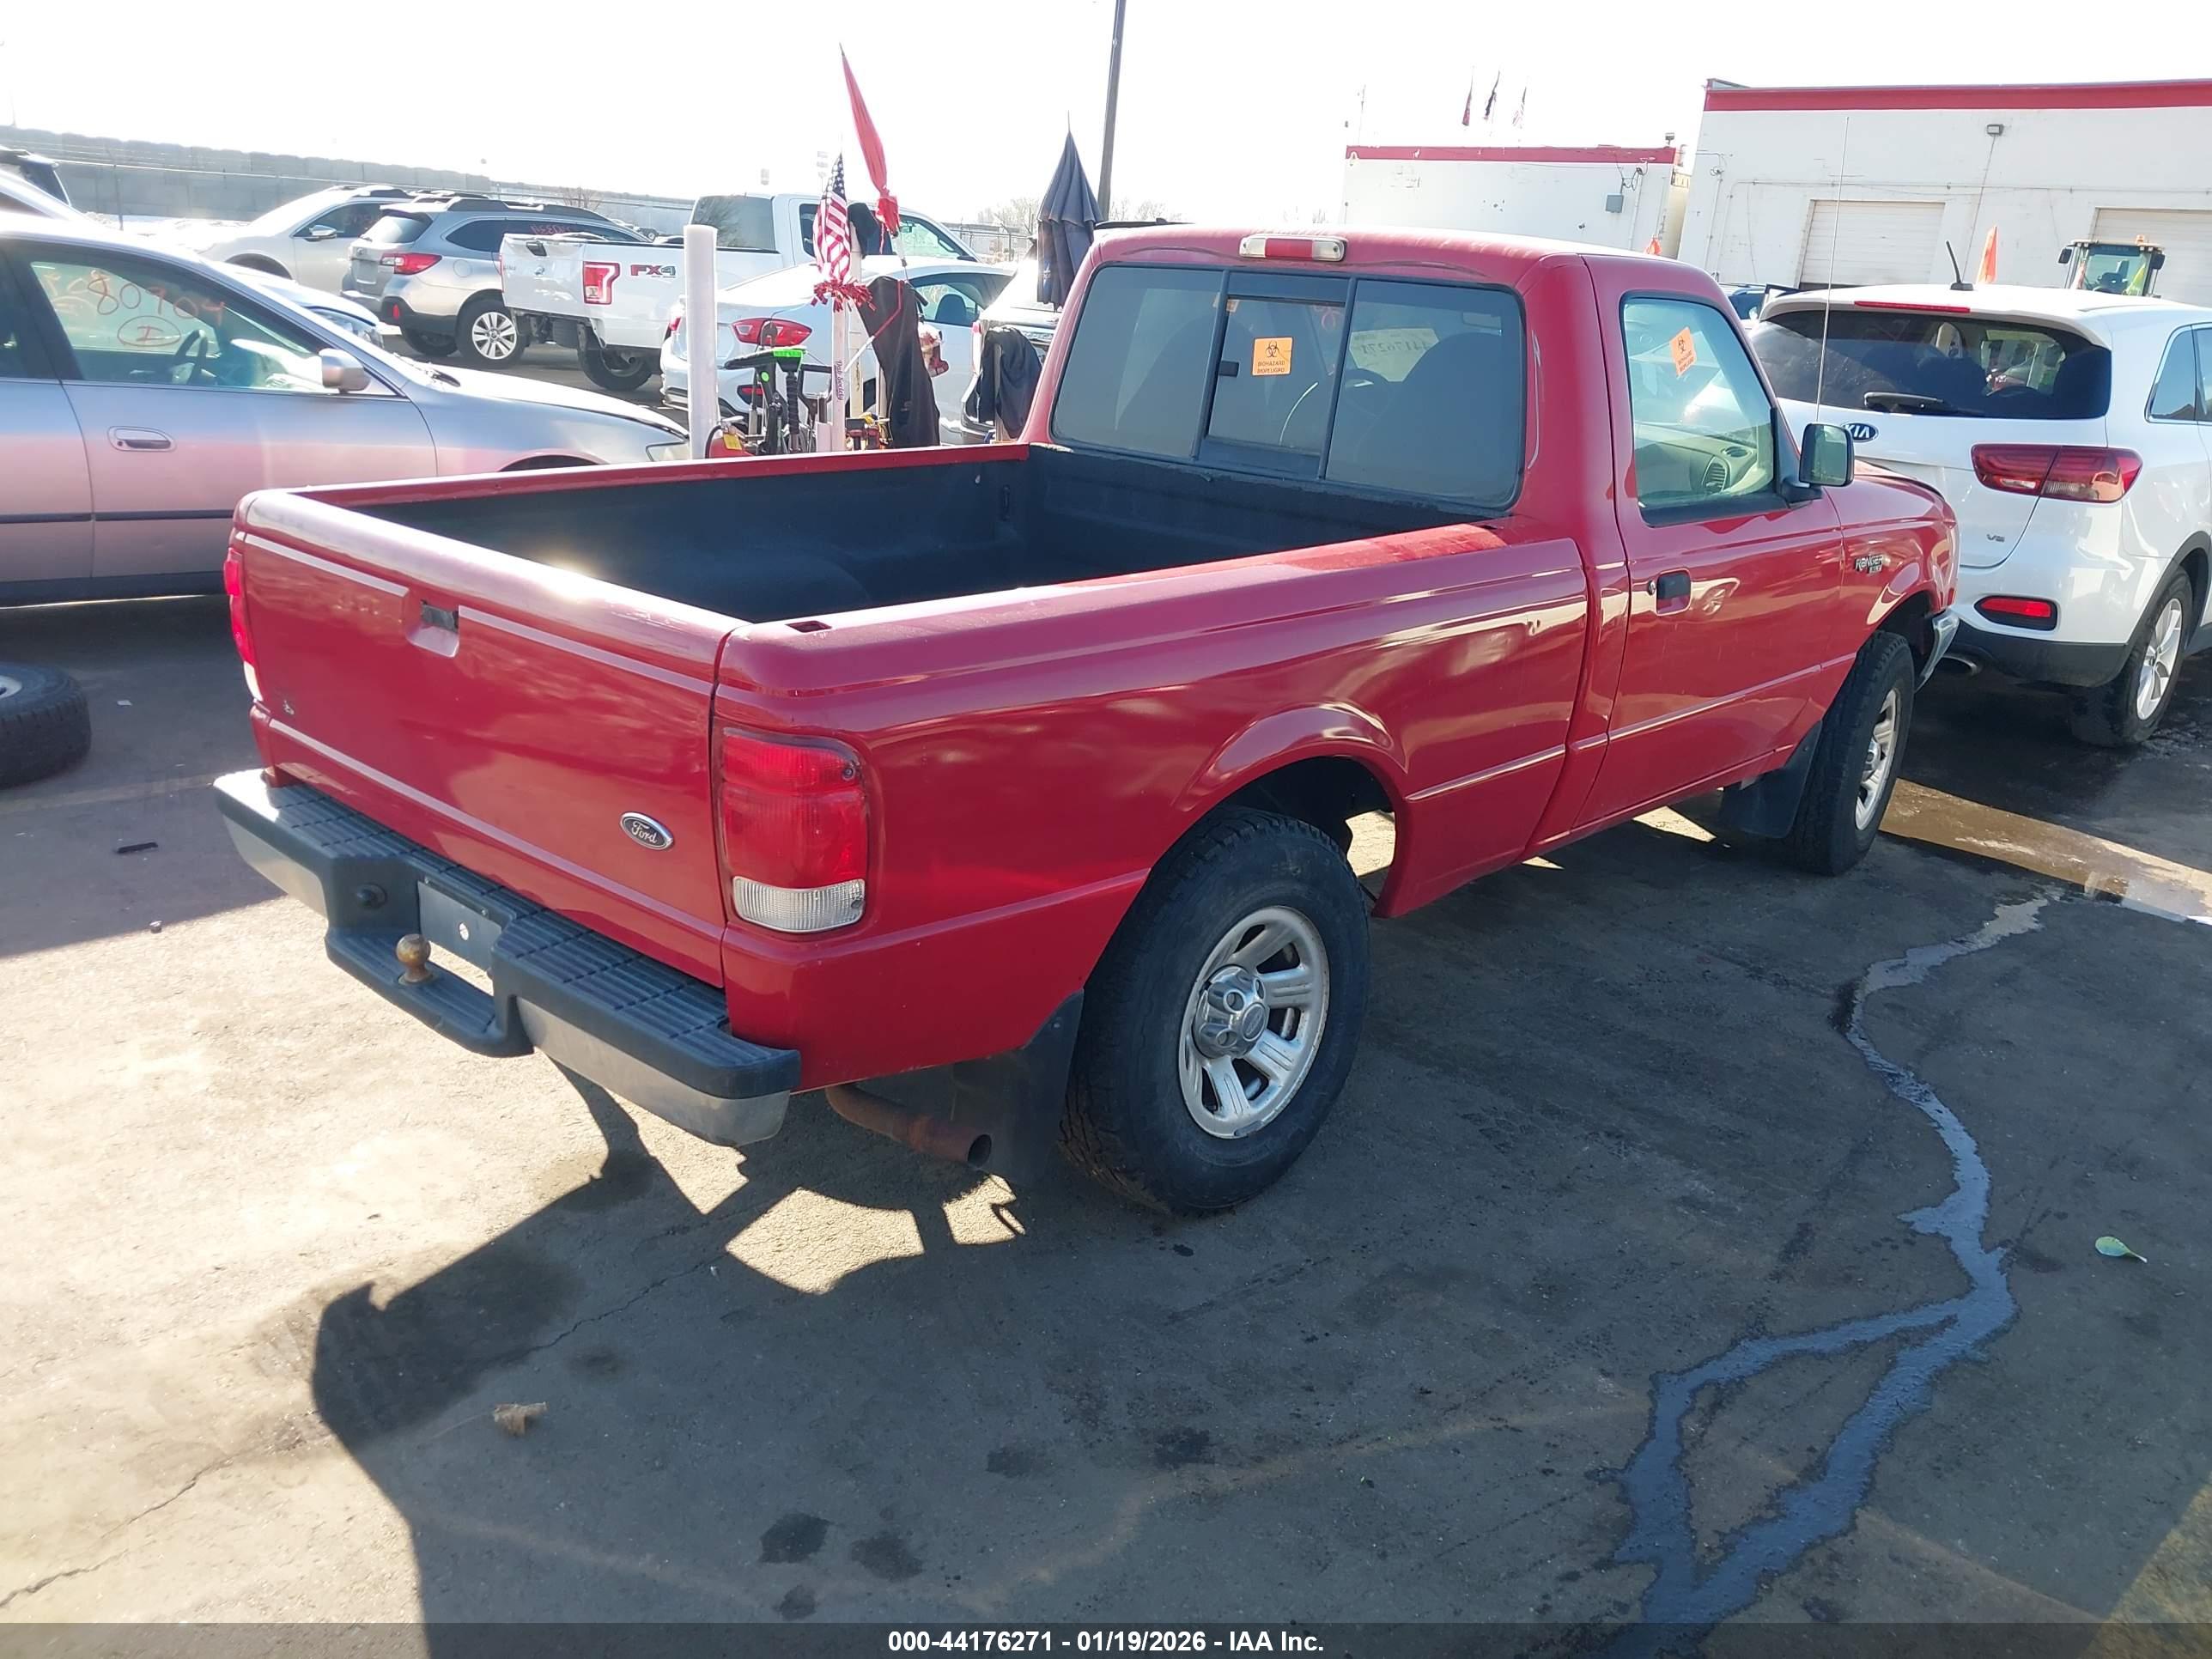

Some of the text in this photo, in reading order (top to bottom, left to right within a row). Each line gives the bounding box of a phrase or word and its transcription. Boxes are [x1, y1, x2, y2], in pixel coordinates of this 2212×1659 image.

[631, 264, 676, 276] FX4
[1845, 424, 1870, 438] KIA
[631, 821, 658, 843] Ford
